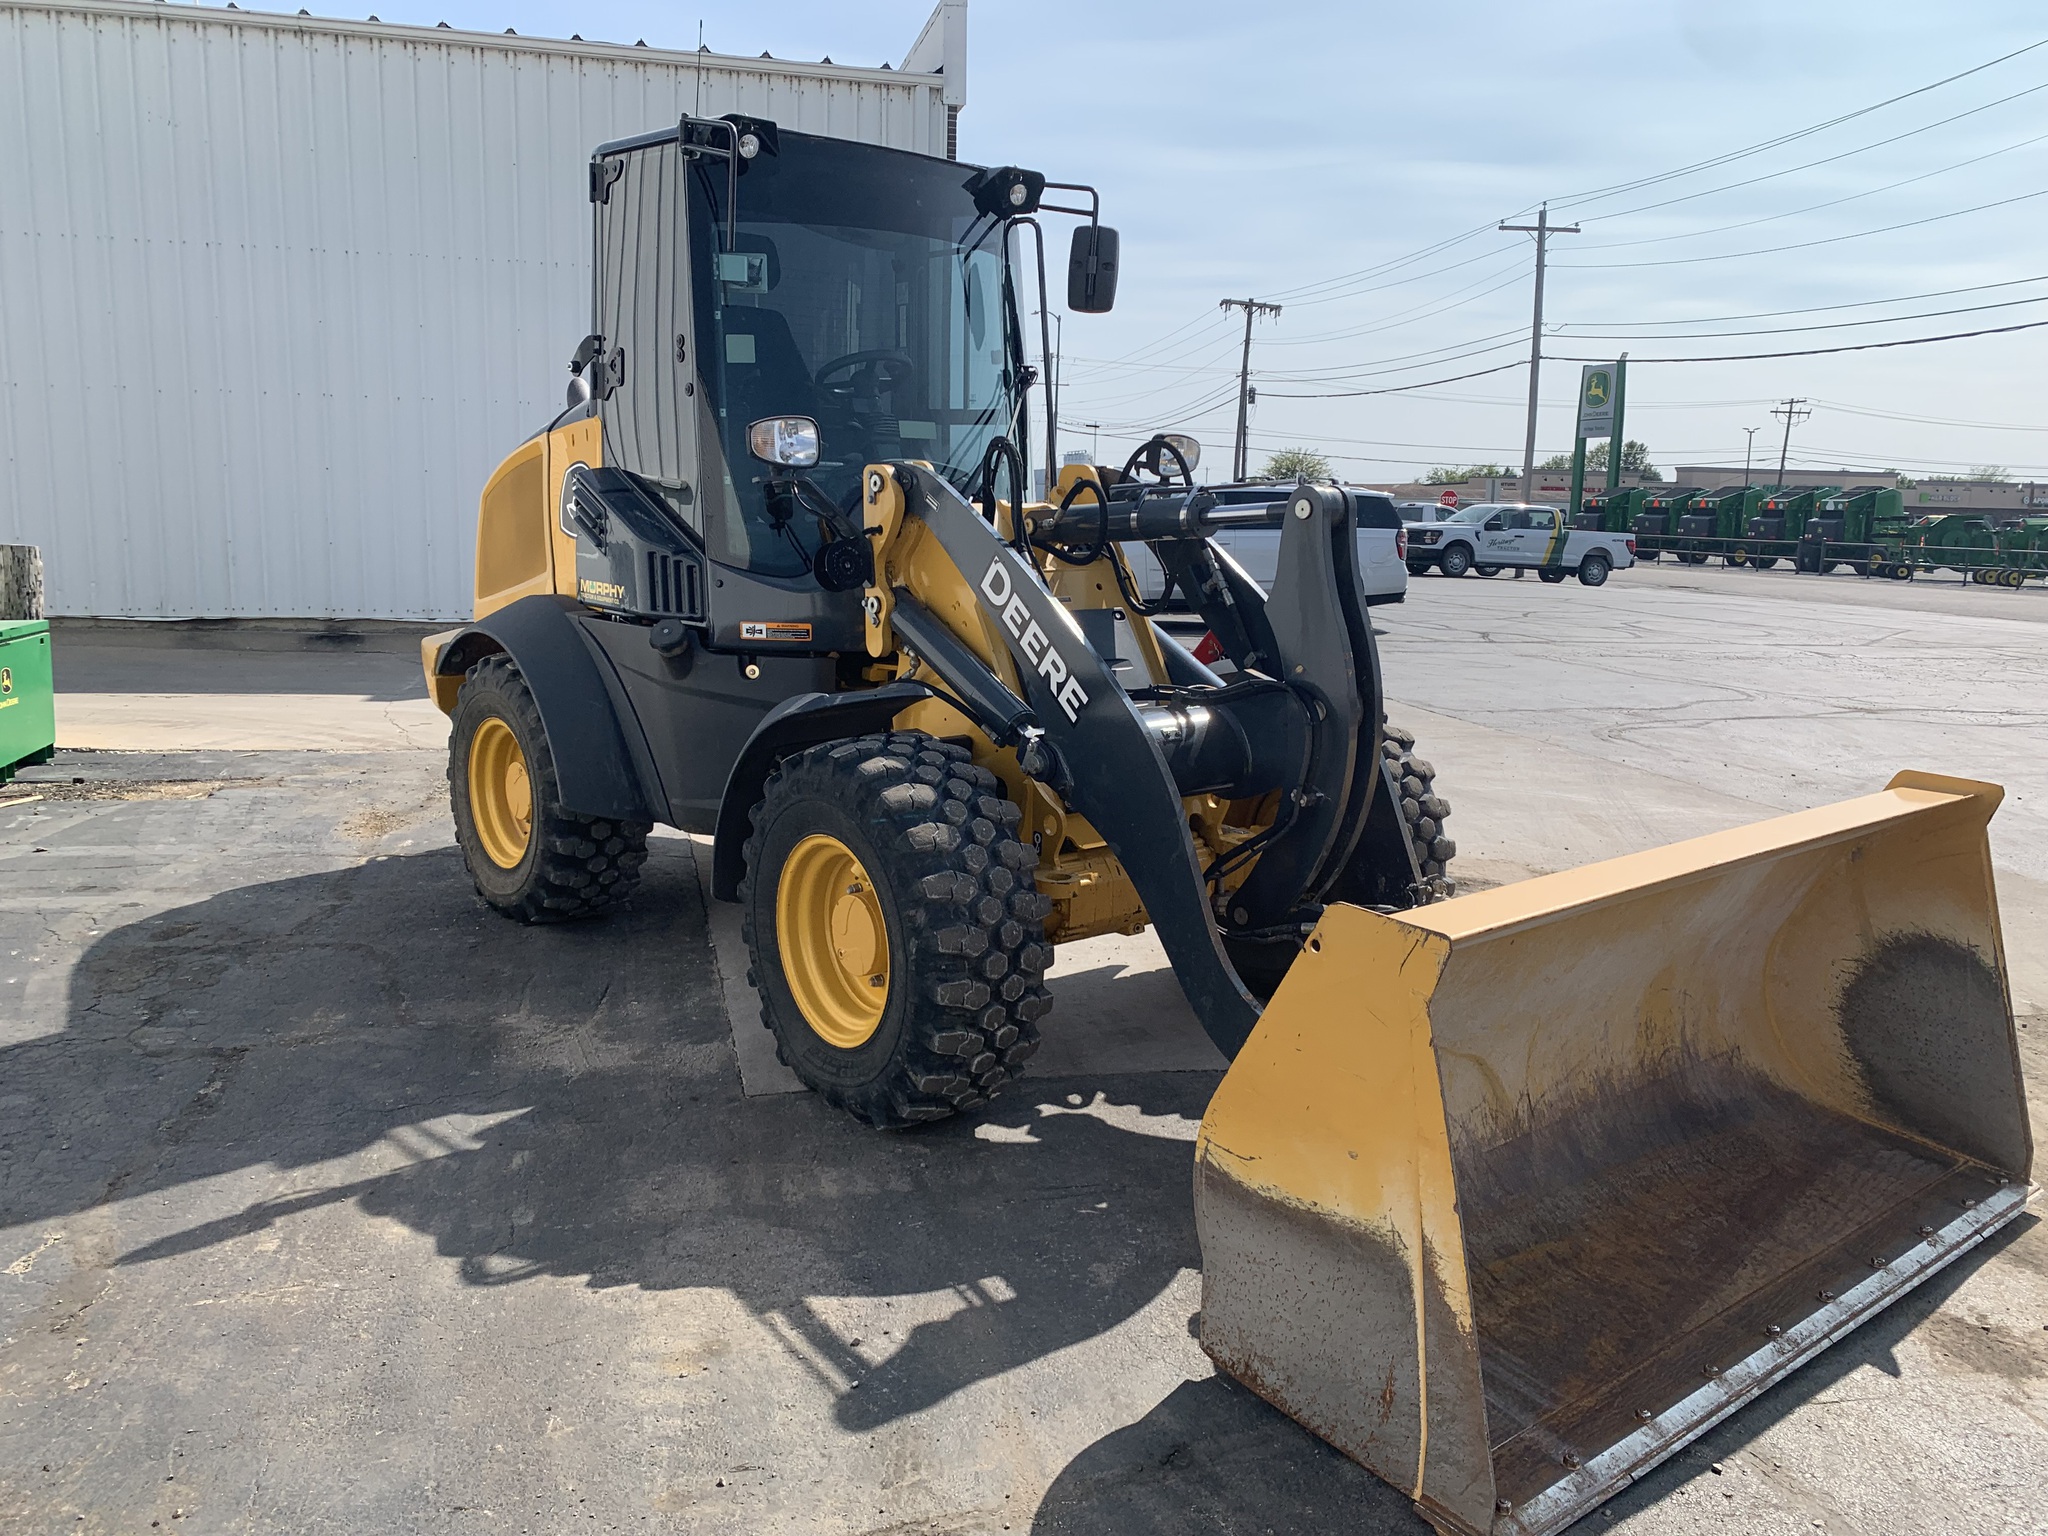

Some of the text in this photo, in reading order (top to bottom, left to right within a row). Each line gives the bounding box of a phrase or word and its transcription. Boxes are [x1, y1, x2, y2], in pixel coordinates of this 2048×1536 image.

[1486, 538, 1516, 548] Heritage
[580, 579, 624, 598] MURPHY
[980, 556, 1089, 723] DEERE
